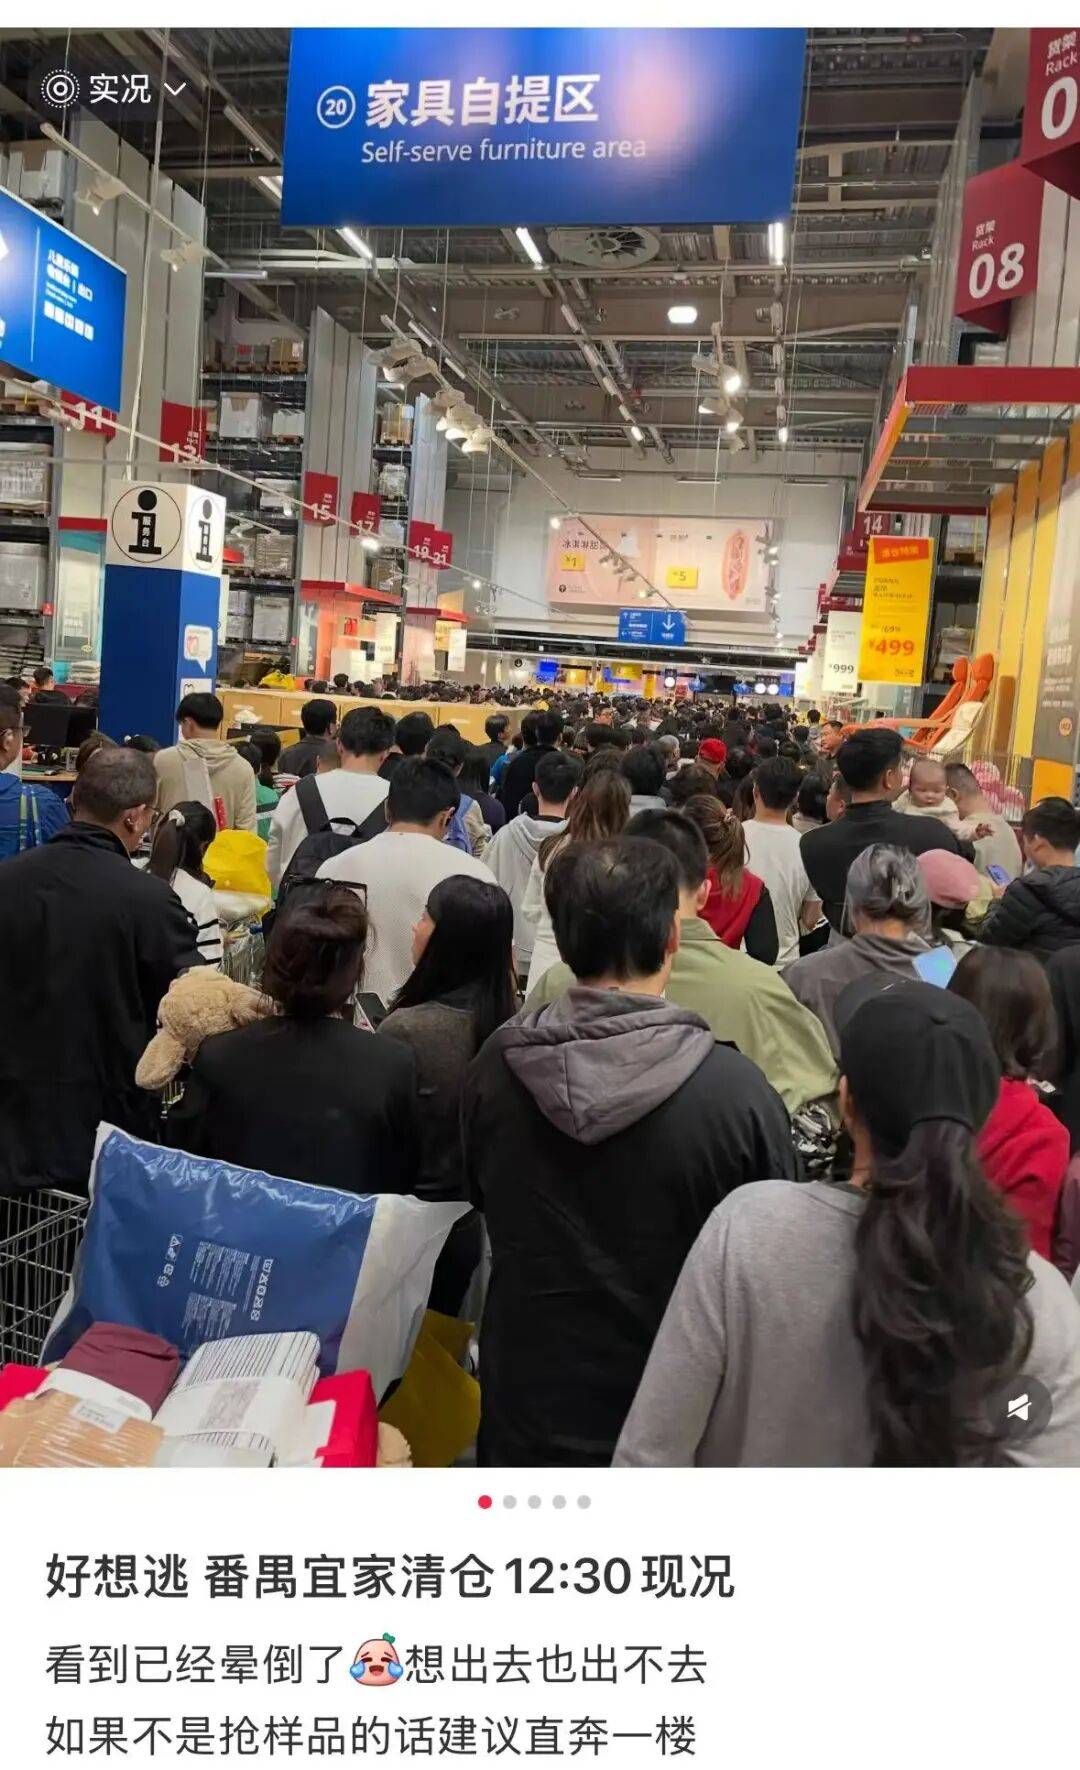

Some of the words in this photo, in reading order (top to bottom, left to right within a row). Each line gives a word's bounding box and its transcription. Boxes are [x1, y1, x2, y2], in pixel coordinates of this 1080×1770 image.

[1045, 51, 1078, 76] Rack
[365, 75, 601, 128] 家具自提区
[361, 140, 473, 163] Self-serve
[480, 138, 586, 161] furniture
[593, 139, 646, 159] area
[972, 235, 994, 252] Rack
[969, 242, 1025, 299] 08
[310, 502, 331, 521] 15
[863, 515, 883, 535] 14
[868, 637, 916, 657] ¥499
